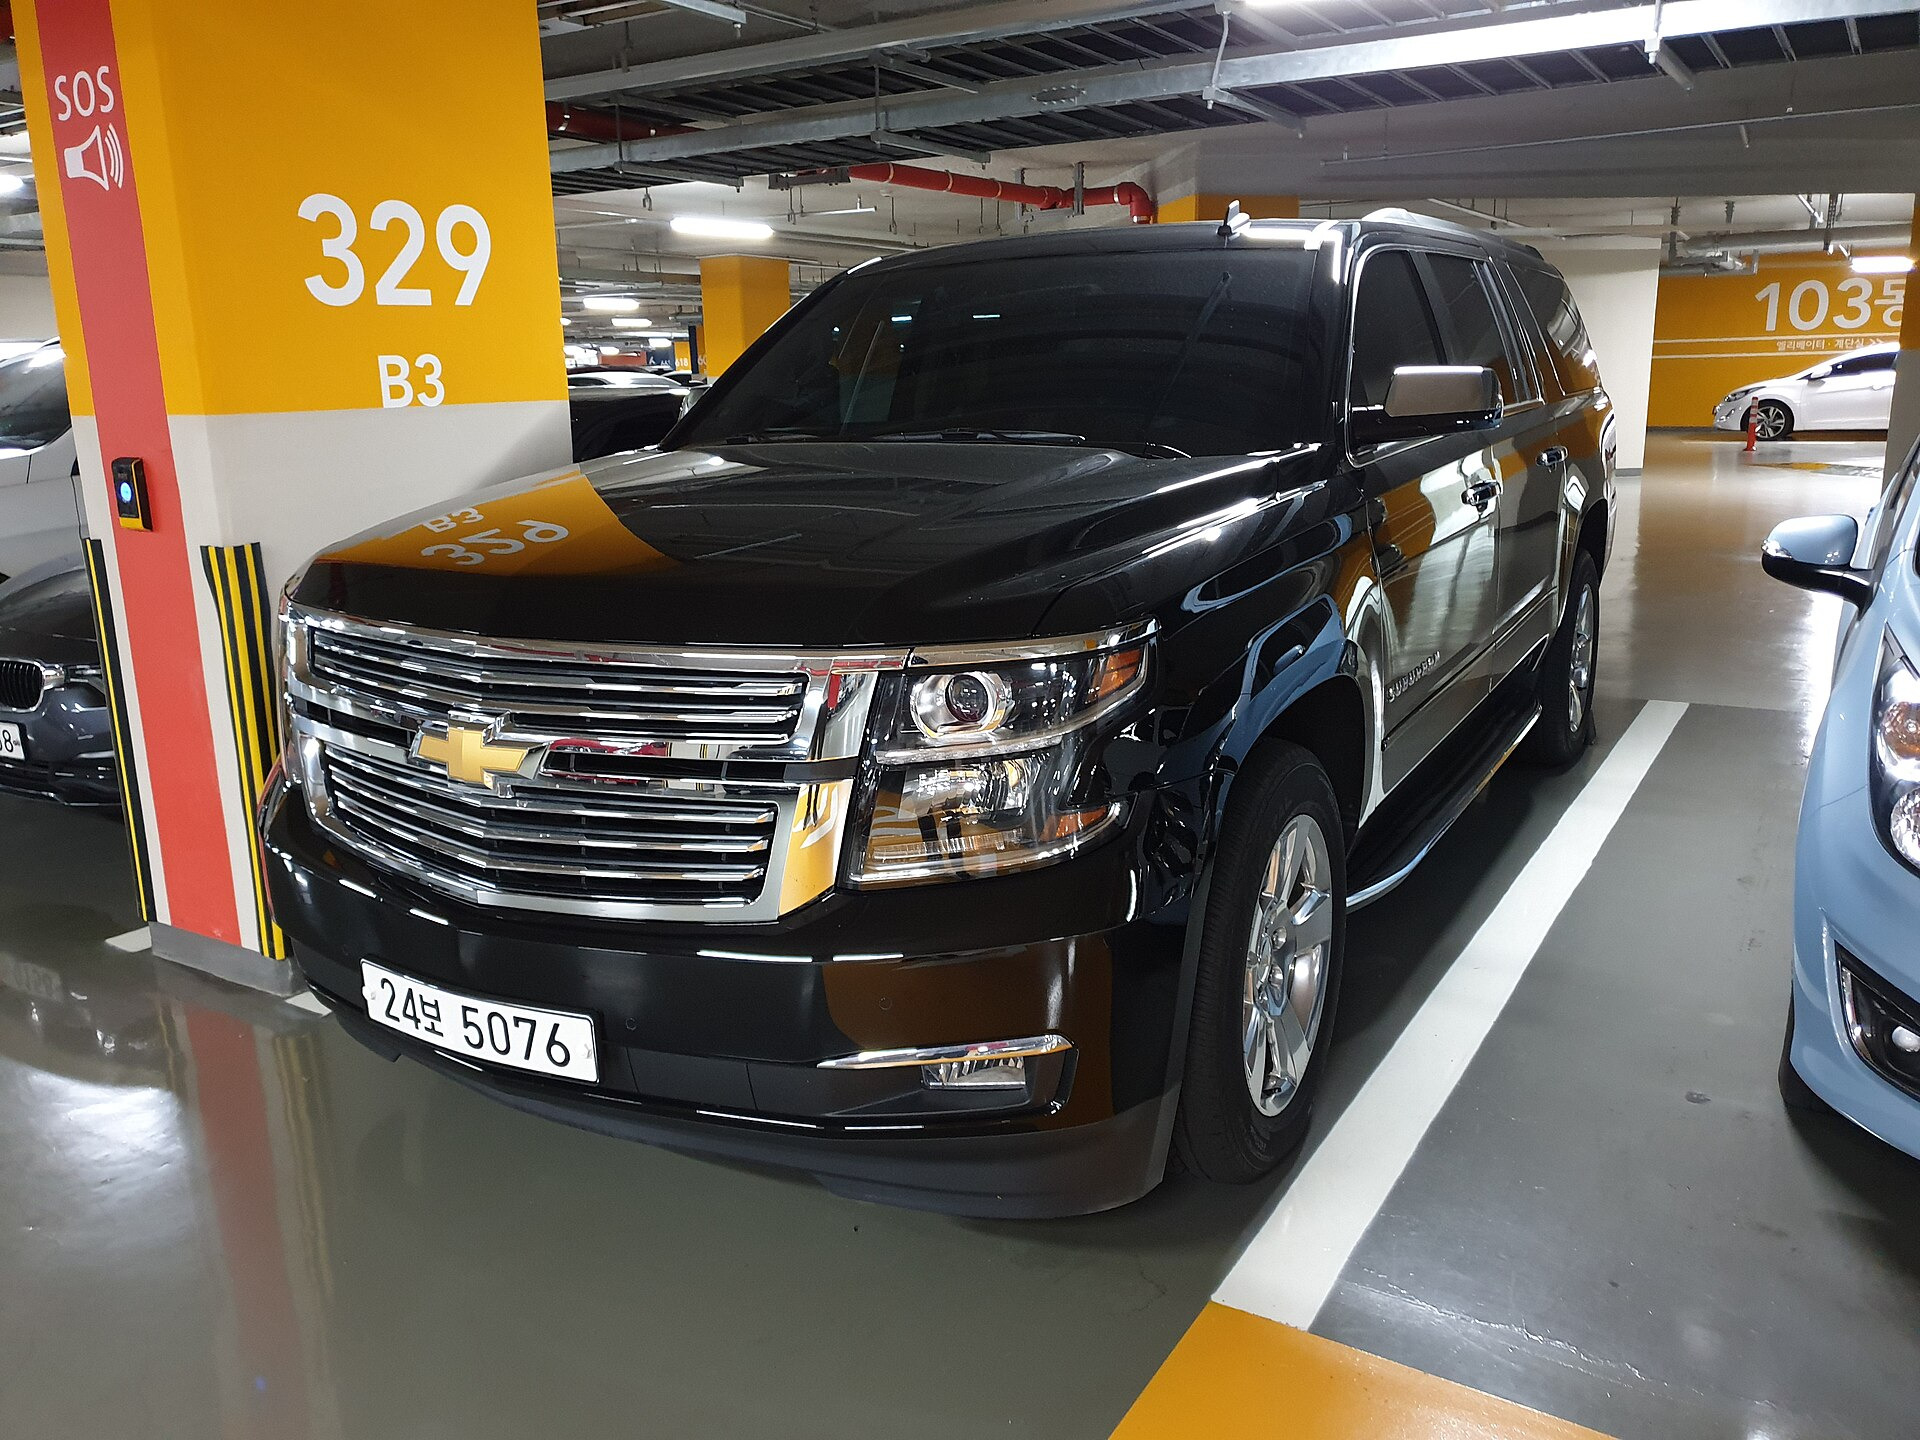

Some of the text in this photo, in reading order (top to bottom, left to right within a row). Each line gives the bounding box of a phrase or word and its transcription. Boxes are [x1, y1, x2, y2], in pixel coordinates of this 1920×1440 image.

[54, 65, 116, 122] SOS
[297, 193, 492, 307] 329
[1754, 277, 1907, 332] 103동
[377, 354, 446, 409] B3
[674, 358, 689, 367] 618
[380, 977, 571, 1067] 24보 5076
